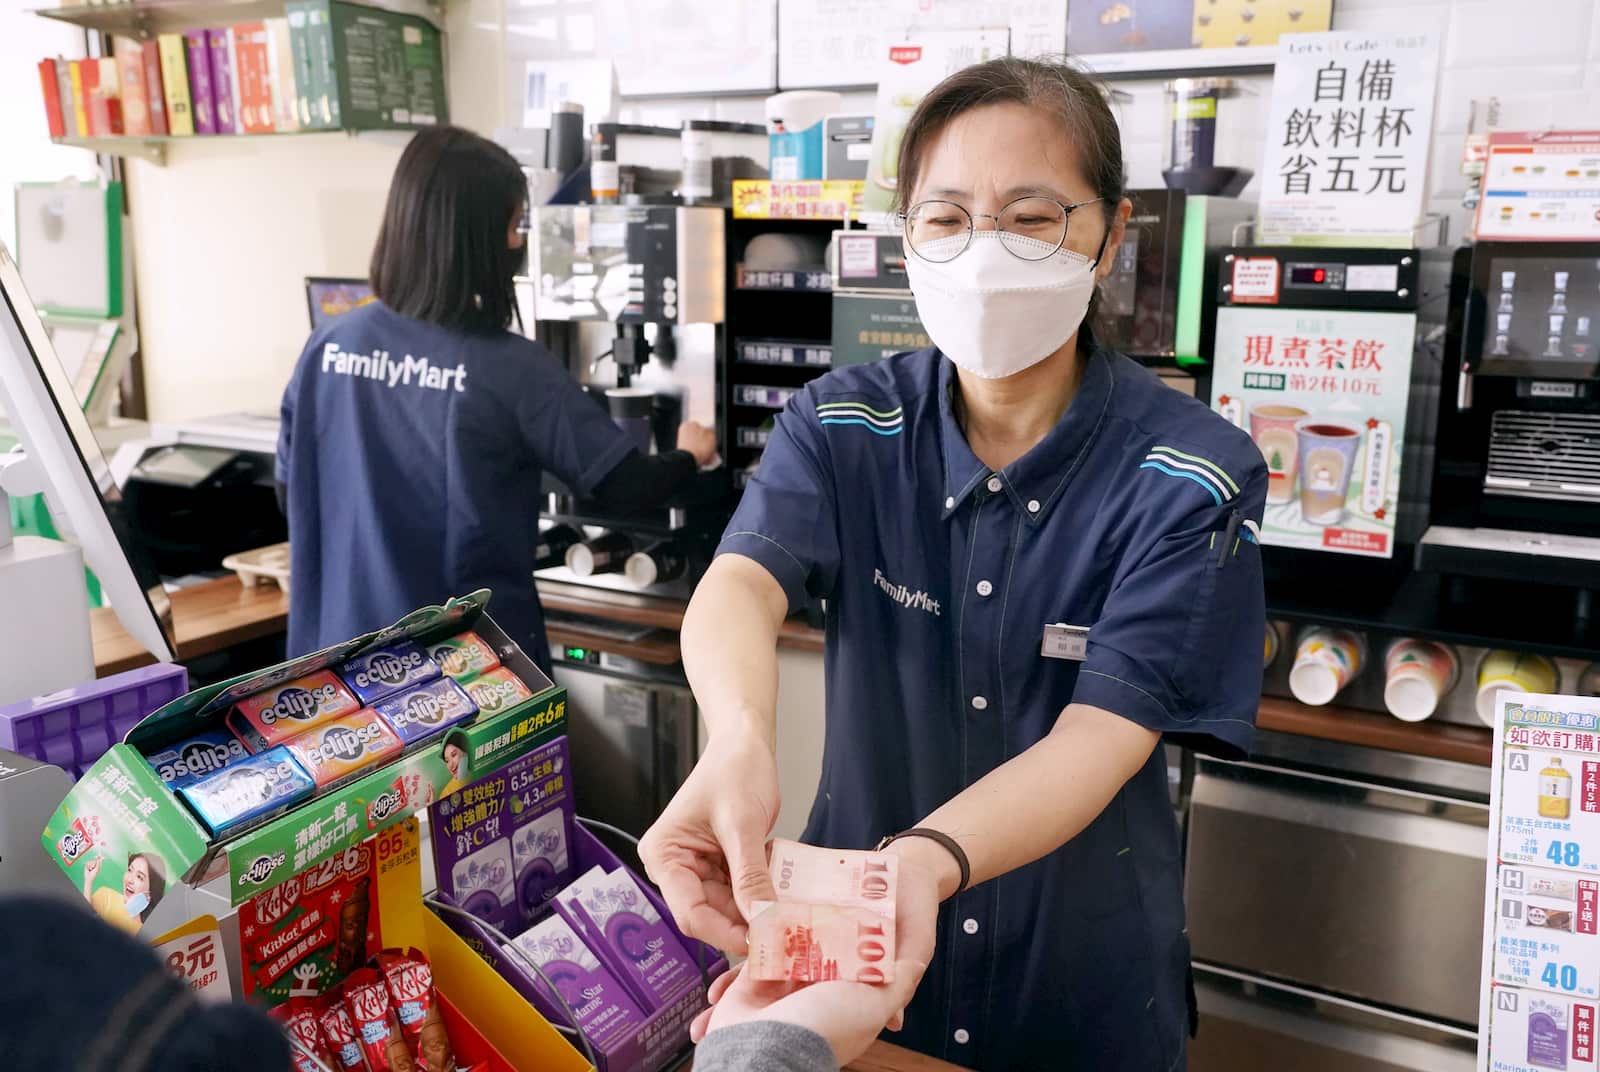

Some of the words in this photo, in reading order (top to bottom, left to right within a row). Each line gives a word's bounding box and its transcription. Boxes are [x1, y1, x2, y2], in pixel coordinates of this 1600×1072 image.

[1313, 59, 1396, 102] 自備
[1283, 106, 1415, 149] 飲料杯
[1280, 153, 1407, 195] 省五元
[322, 342, 467, 392] FamilyMart
[1243, 335, 1385, 372] 現煮茶飲
[1289, 373, 1384, 396] 第2杯10元
[873, 568, 941, 616] FamilyMart
[355, 650, 423, 688] eclipse
[260, 683, 338, 725] eclipse
[393, 689, 460, 729] eclipse
[159, 739, 244, 783] eclipse
[308, 721, 381, 766] eclipse
[1511, 755, 1527, 771] A
[463, 778, 506, 808] 雙效給力
[1584, 762, 1598, 812] 第2件5折
[450, 800, 499, 833] 增強體力
[238, 852, 286, 886] eclipse
[1546, 840, 1580, 867] 48
[779, 858, 795, 890] 100
[1506, 871, 1521, 887] H
[645, 937, 665, 951] Star
[387, 963, 433, 1001] KitKat
[581, 984, 604, 1000] Star
[1541, 962, 1578, 991] 40
[351, 981, 389, 1021] KitKat
[1500, 993, 1515, 1011] N
[1577, 1008, 1590, 1059] 單件特價
